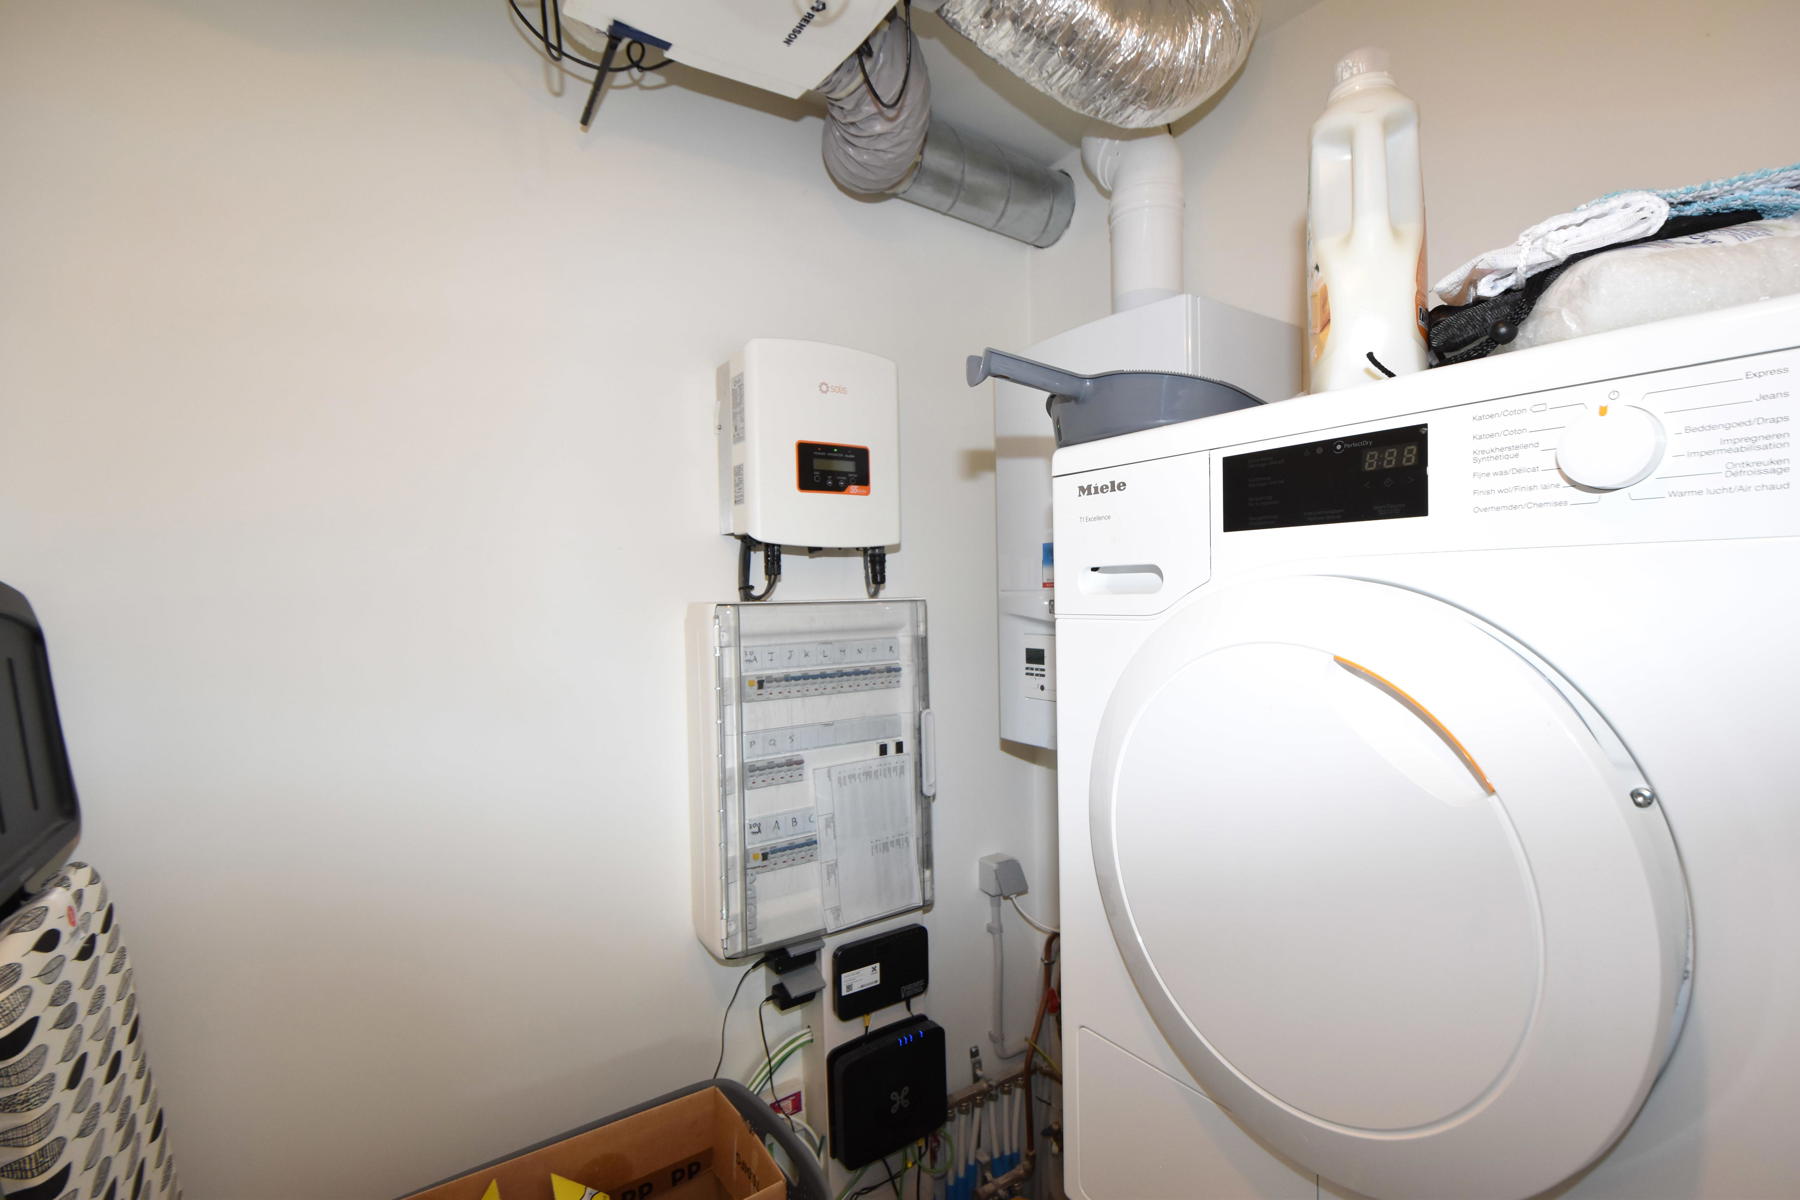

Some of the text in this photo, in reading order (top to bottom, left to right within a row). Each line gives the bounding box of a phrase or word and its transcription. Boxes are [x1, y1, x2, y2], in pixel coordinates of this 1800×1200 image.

[783, 11, 815, 47] RENSON
[1745, 367, 1789, 381] Express
[1755, 391, 1790, 402] Jeans
[1472, 409, 1527, 422] Katoen/Coton
[1472, 428, 1527, 441] Katoen/Coton
[1720, 432, 1790, 445] Impregneren
[1078, 480, 1127, 498] Miele
[1472, 487, 1496, 497] Finish
[1667, 488, 1704, 498] Warme
[1754, 481, 1790, 492] chaud
